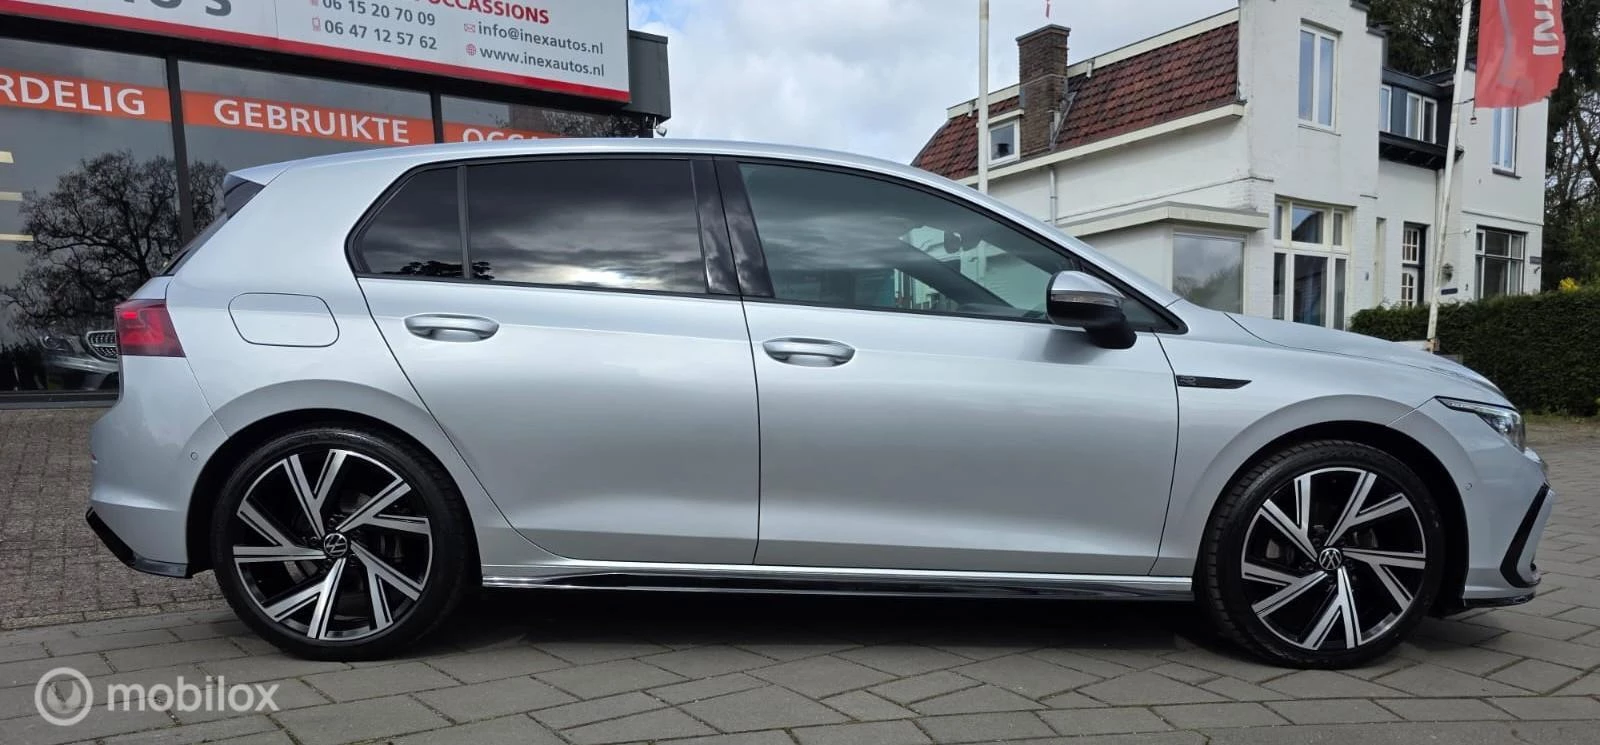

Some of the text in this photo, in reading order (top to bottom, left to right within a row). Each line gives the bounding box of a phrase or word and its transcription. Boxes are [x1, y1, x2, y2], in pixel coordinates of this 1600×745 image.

[323, 0, 436, 26] 06 15 20 70 09
[428, 0, 550, 24] CASSIONS
[324, 19, 437, 50] 06 47 12 57 62
[478, 21, 604, 54] info@inexautos.nl
[480, 47, 605, 77] www.inexautos.nl
[214, 99, 409, 144] GEBRUIKTE
